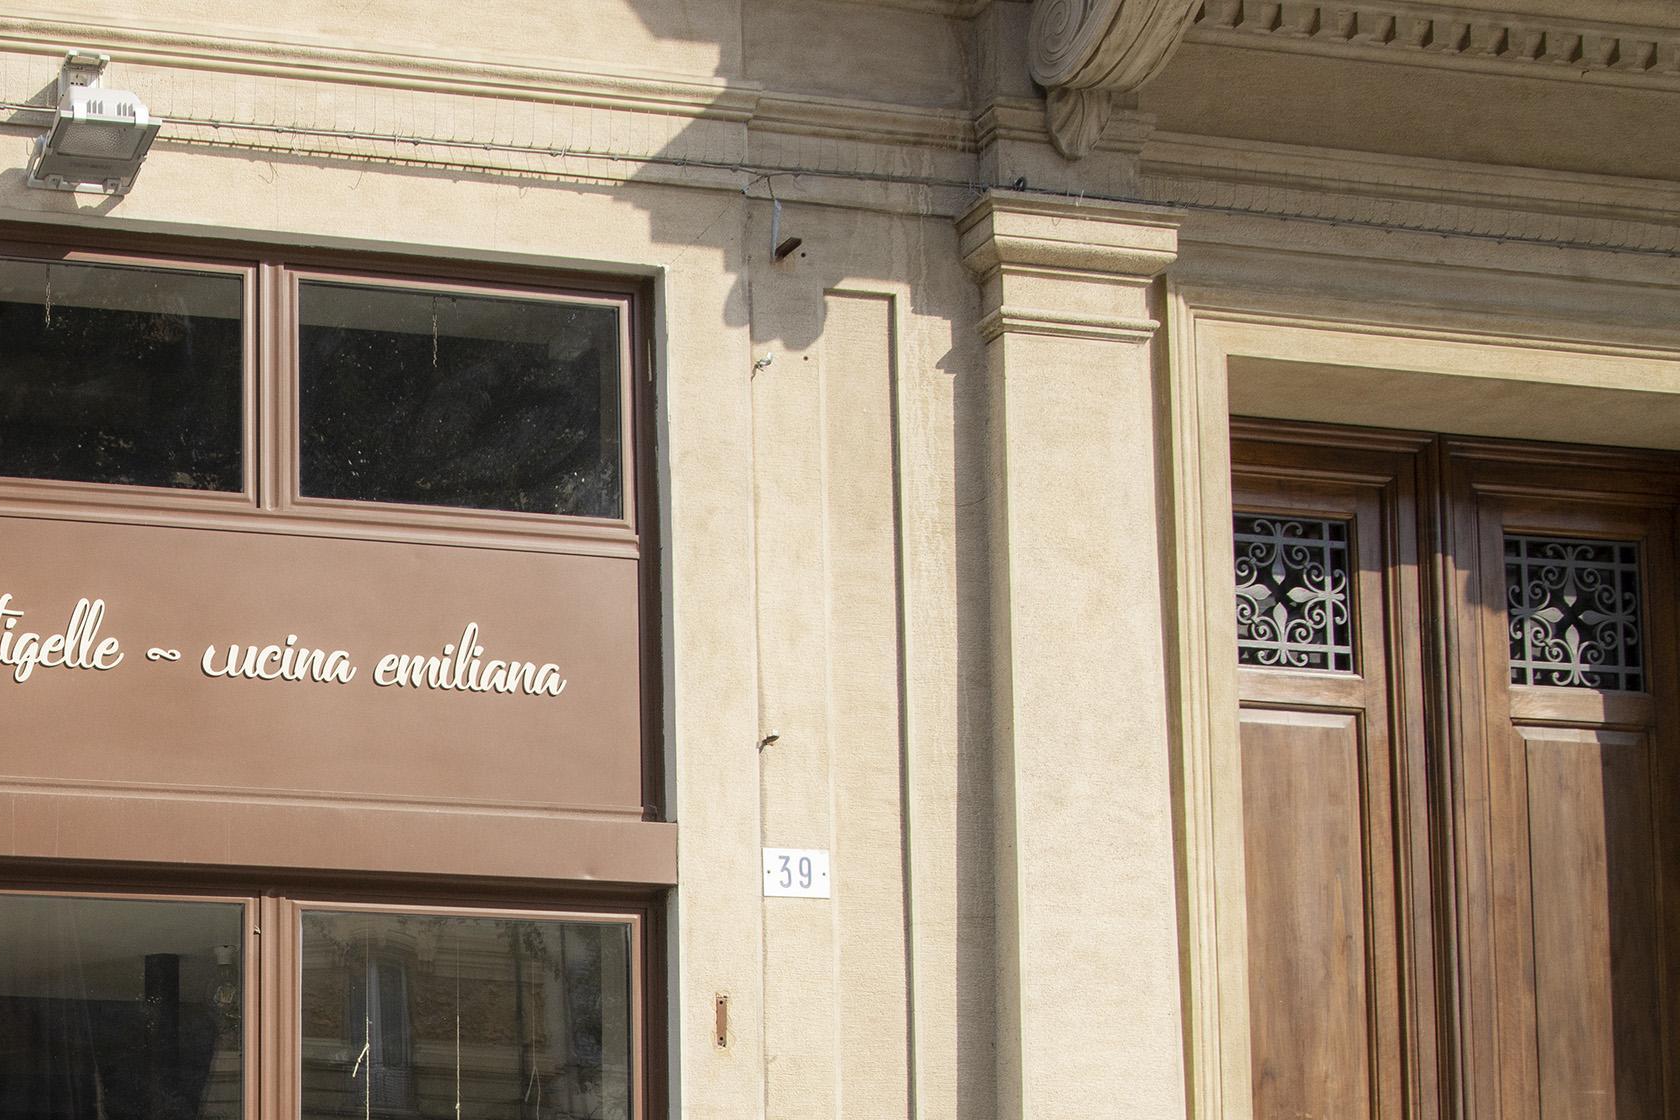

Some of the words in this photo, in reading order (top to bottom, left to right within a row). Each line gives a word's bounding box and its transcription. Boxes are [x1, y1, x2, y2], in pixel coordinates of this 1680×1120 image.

[202, 634, 357, 683] cucina
[374, 622, 567, 696] emiliana
[778, 855, 812, 888] 39
